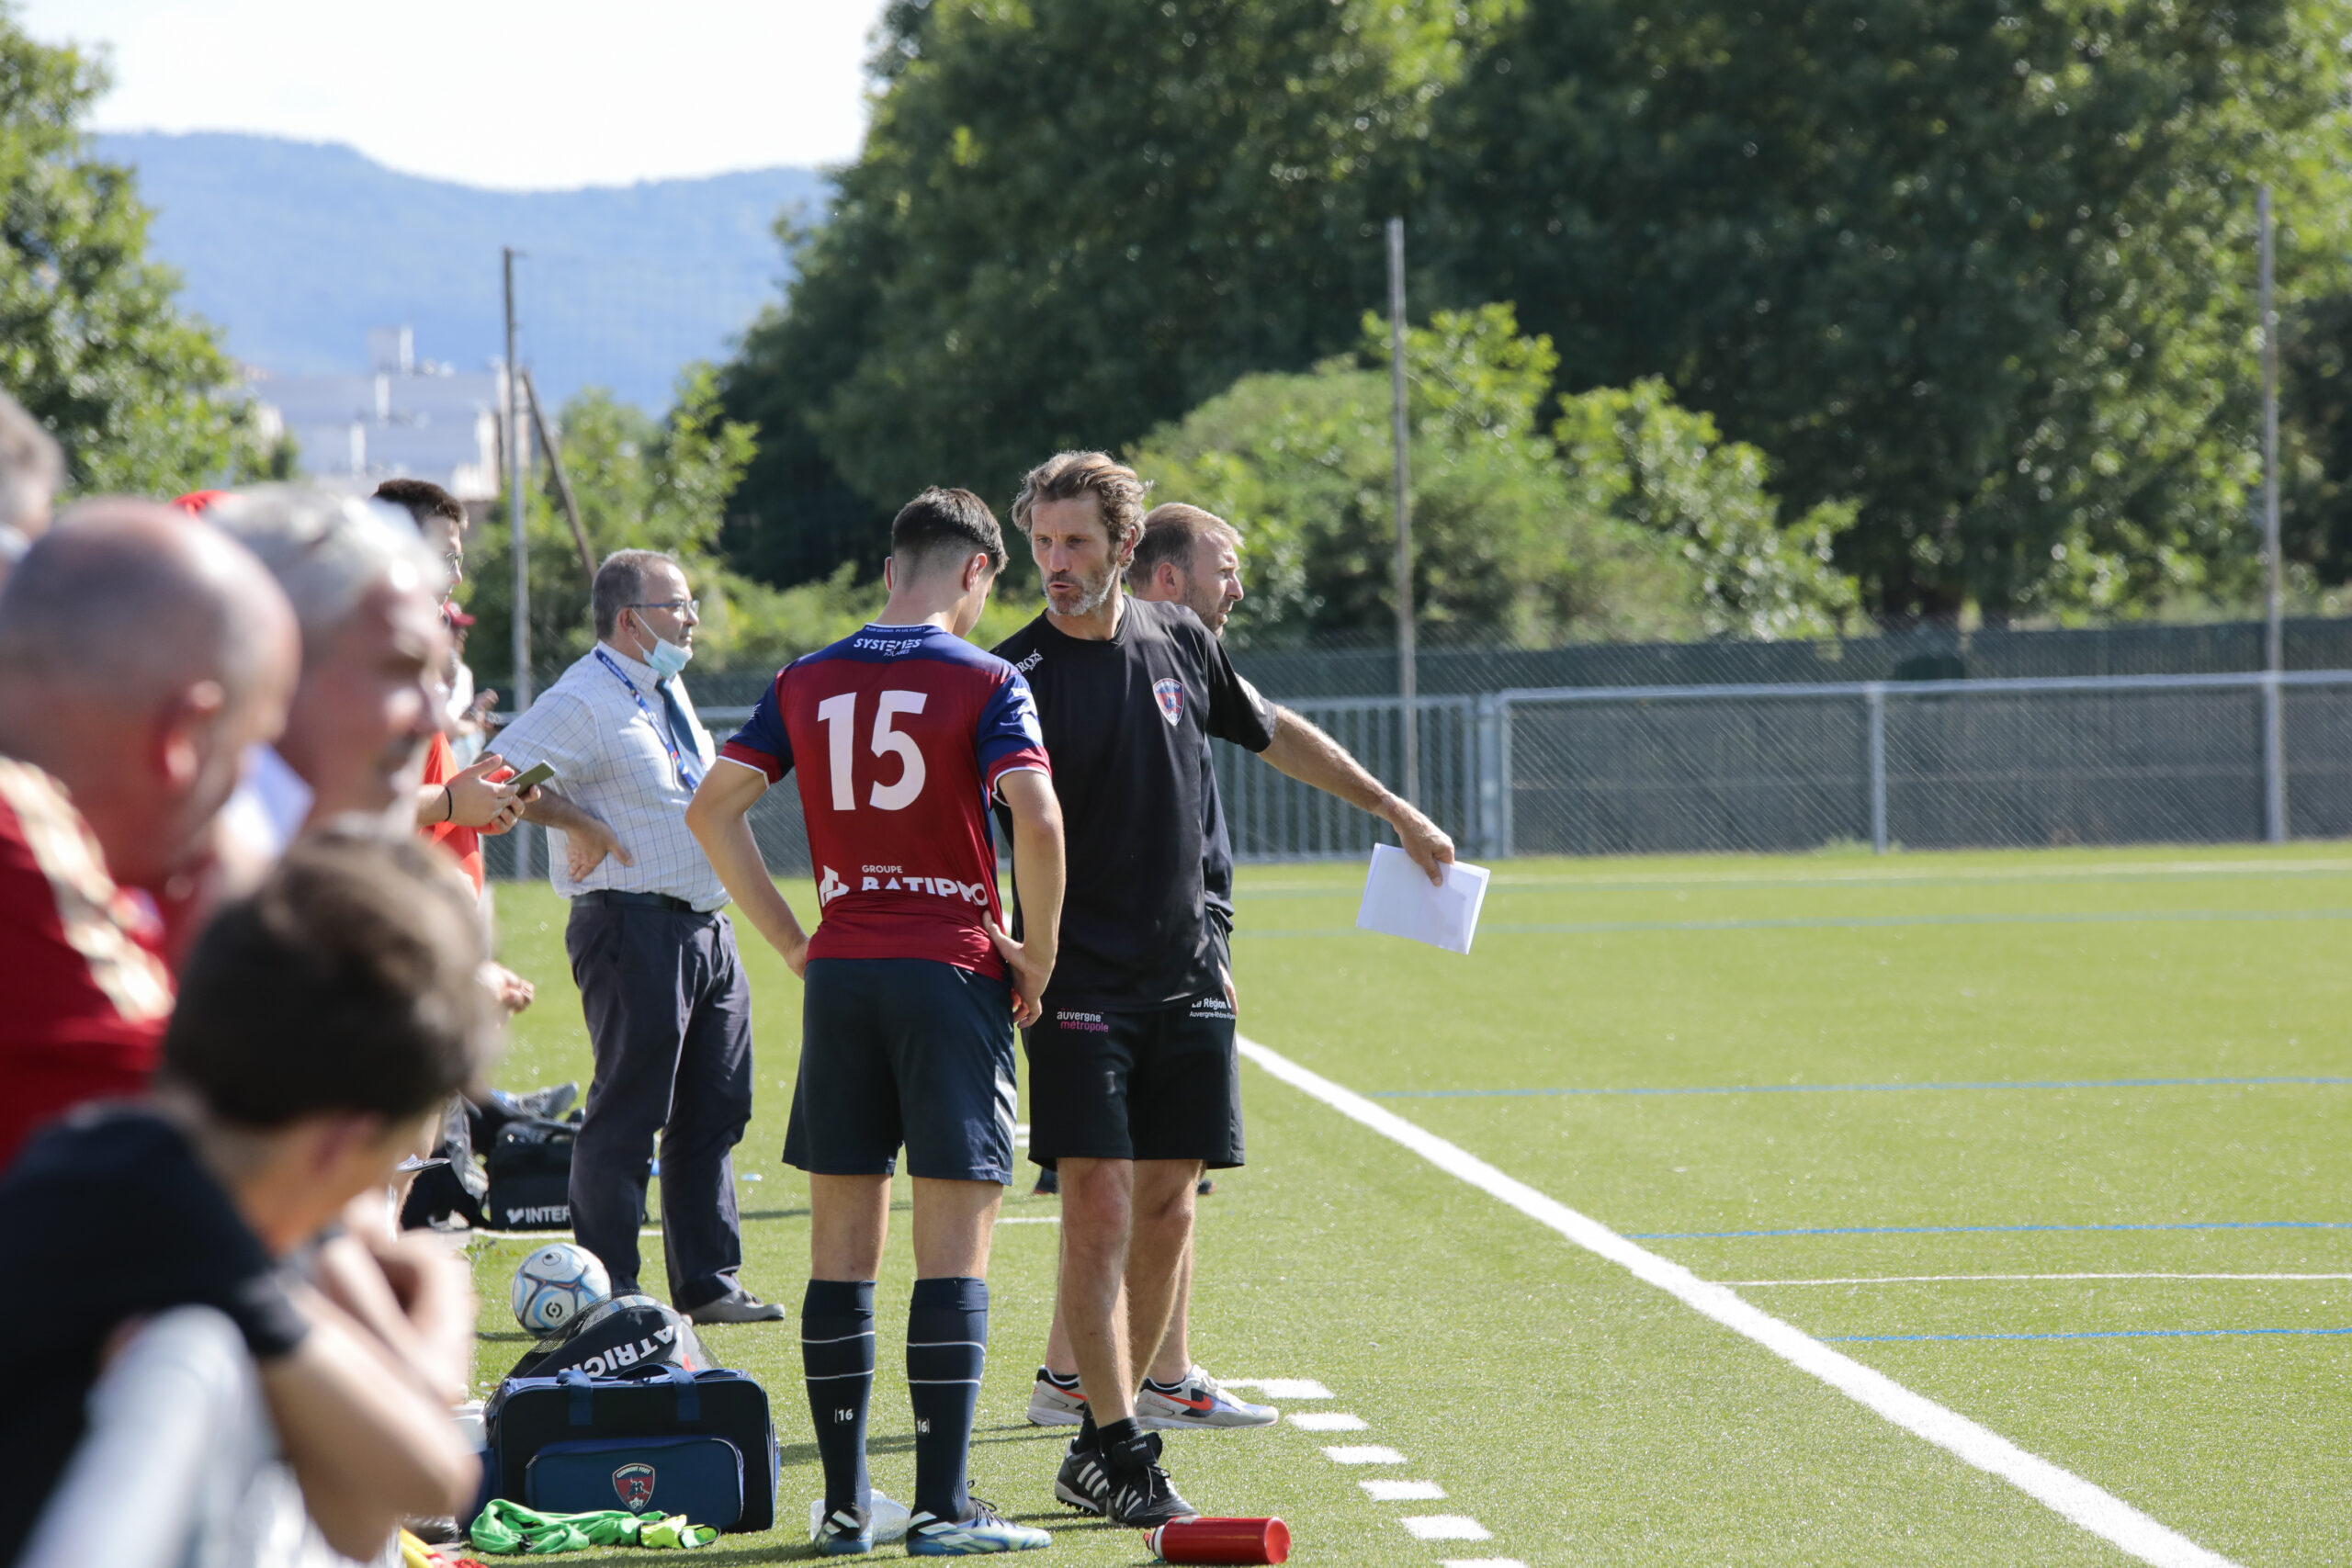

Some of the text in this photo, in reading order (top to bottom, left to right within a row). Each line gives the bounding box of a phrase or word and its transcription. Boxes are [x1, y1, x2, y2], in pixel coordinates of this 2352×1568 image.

[817, 689, 928, 811] 15
[862, 865, 903, 874] GROUPE
[1204, 998, 1227, 1010] Région
[1057, 1011, 1102, 1022] auvergne
[1060, 1021, 1109, 1032] métropole
[559, 1325, 674, 1378] ATRIC
[838, 1408, 854, 1421] 16
[917, 1419, 928, 1432] 16
